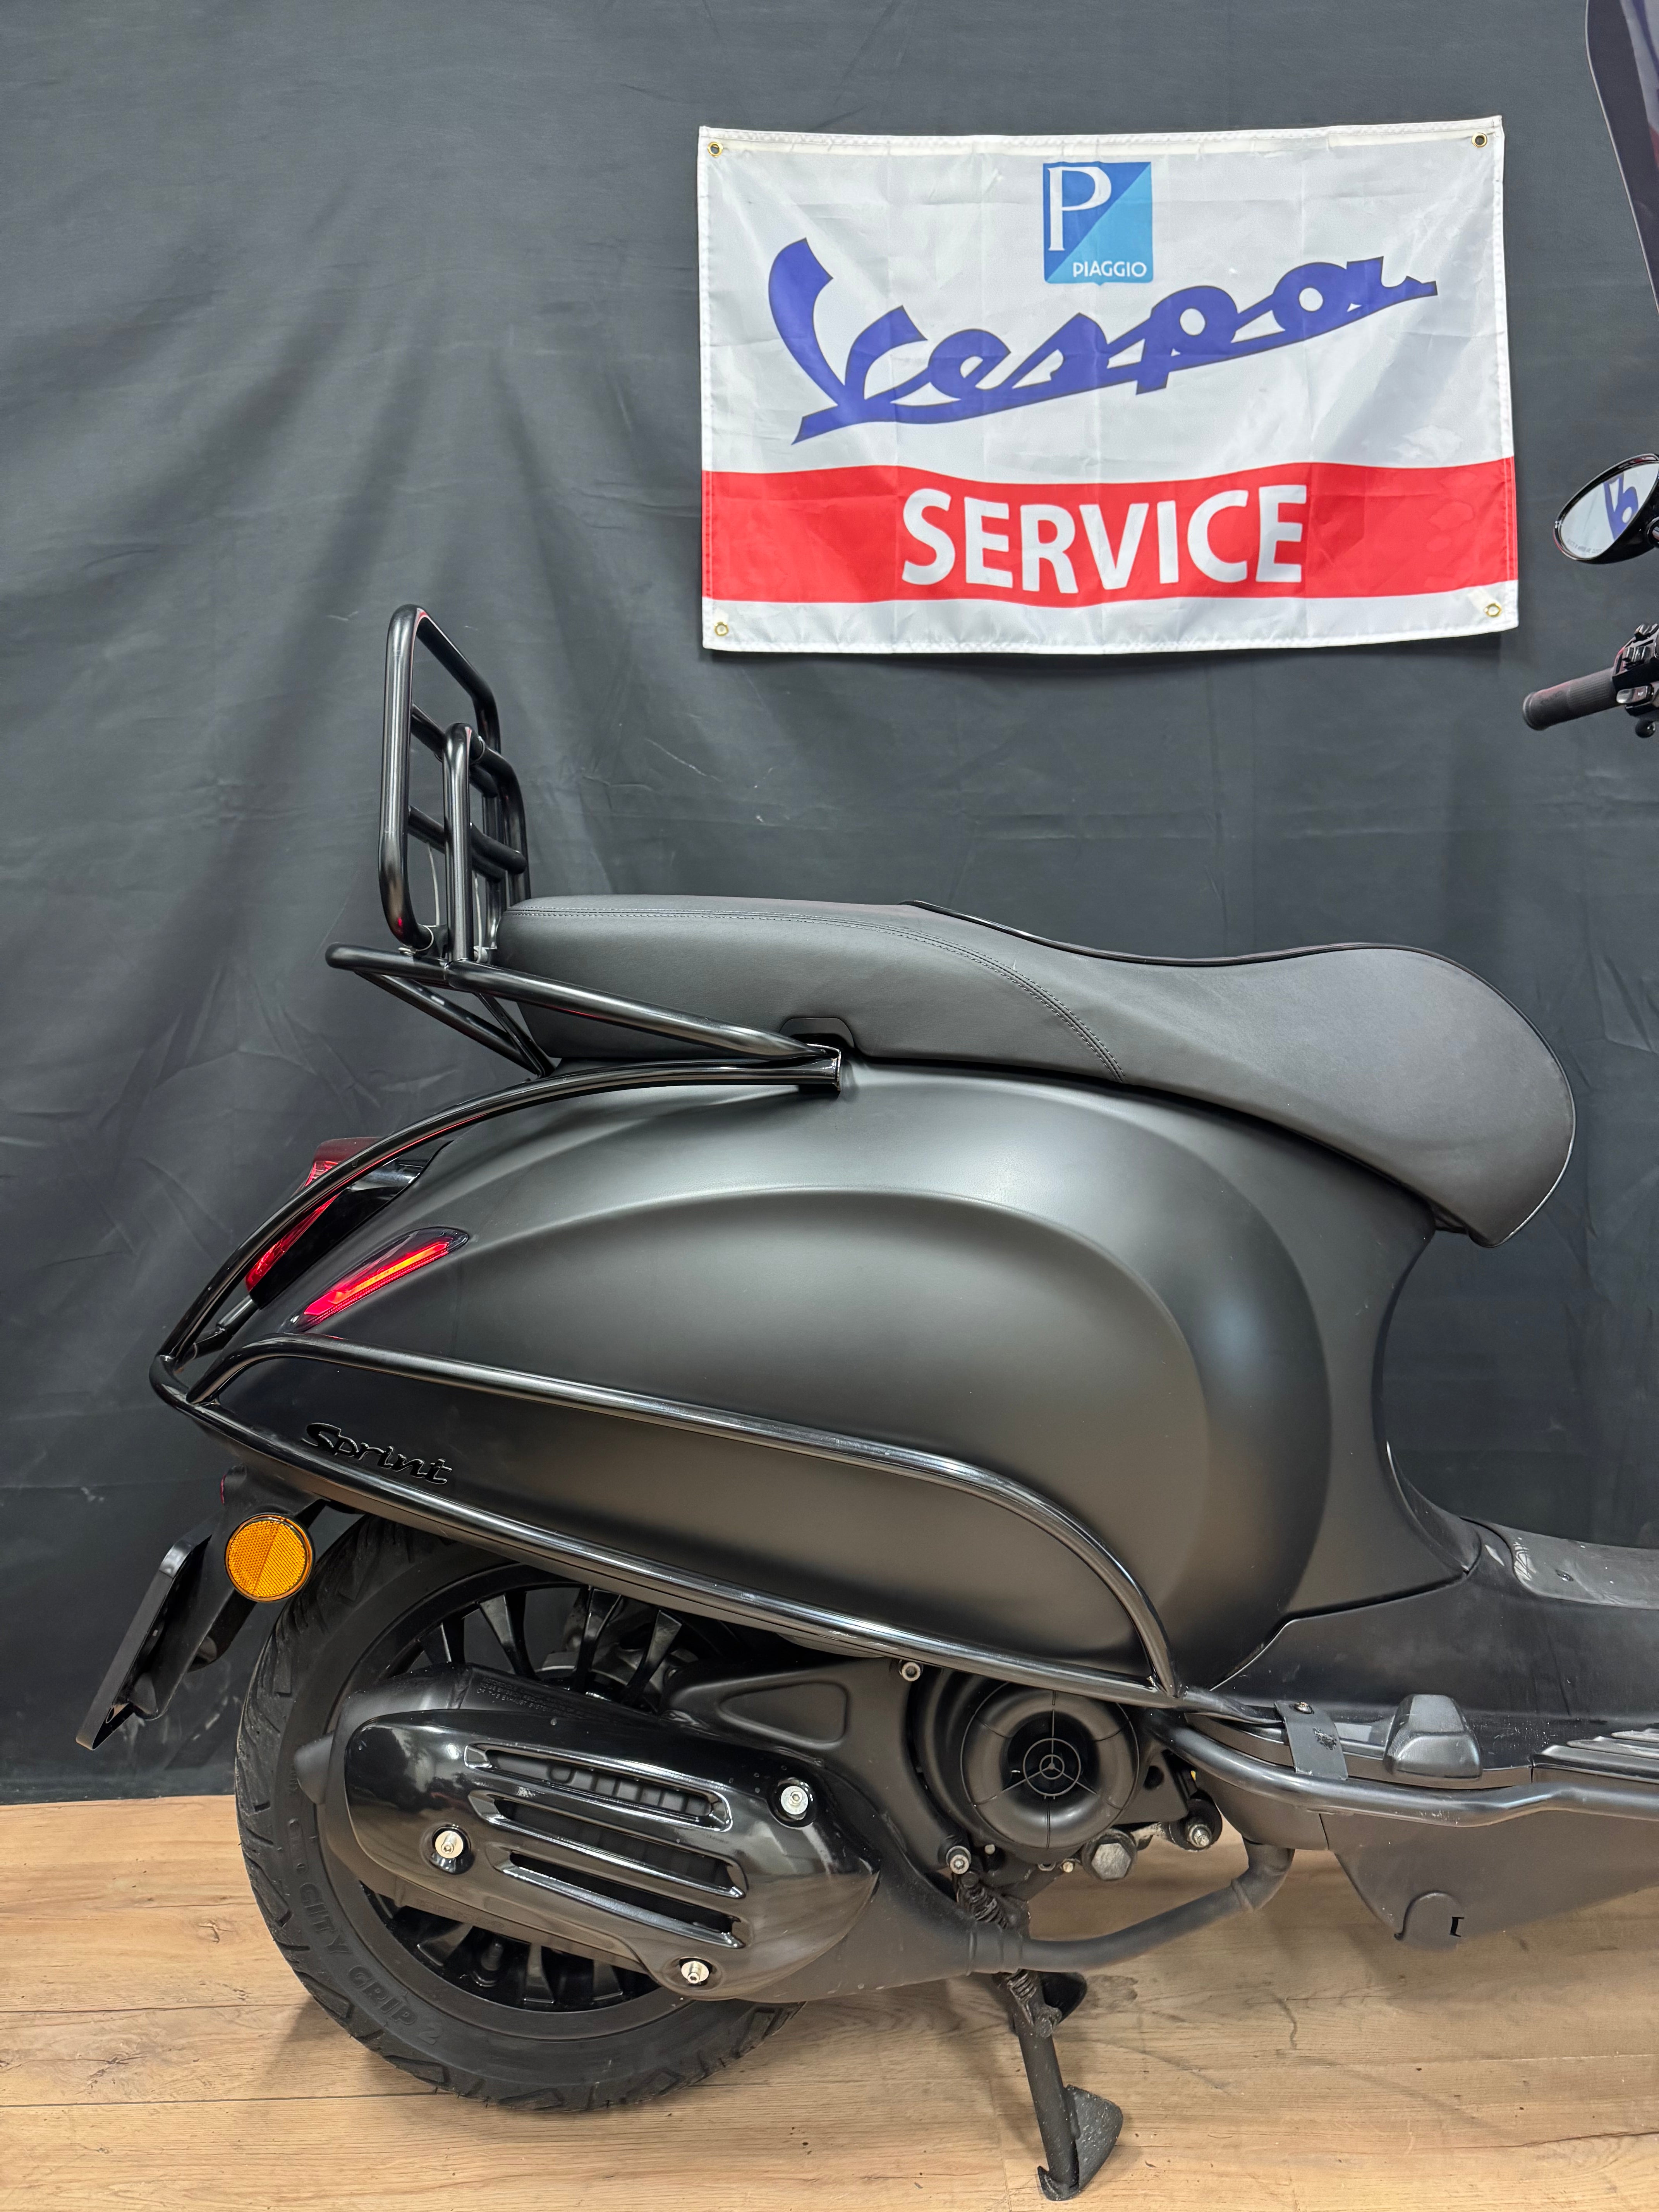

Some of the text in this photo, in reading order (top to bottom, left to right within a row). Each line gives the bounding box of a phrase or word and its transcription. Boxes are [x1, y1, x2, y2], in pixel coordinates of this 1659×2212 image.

[1048, 167, 1111, 251] P
[1073, 261, 1147, 278] PIAGGIO
[768, 237, 1437, 445] Vespa
[902, 485, 1307, 594] SERVICE
[301, 1422, 453, 1485] Sprint
[299, 1883, 353, 1954] CITY
[348, 1965, 418, 2026] GRIP
